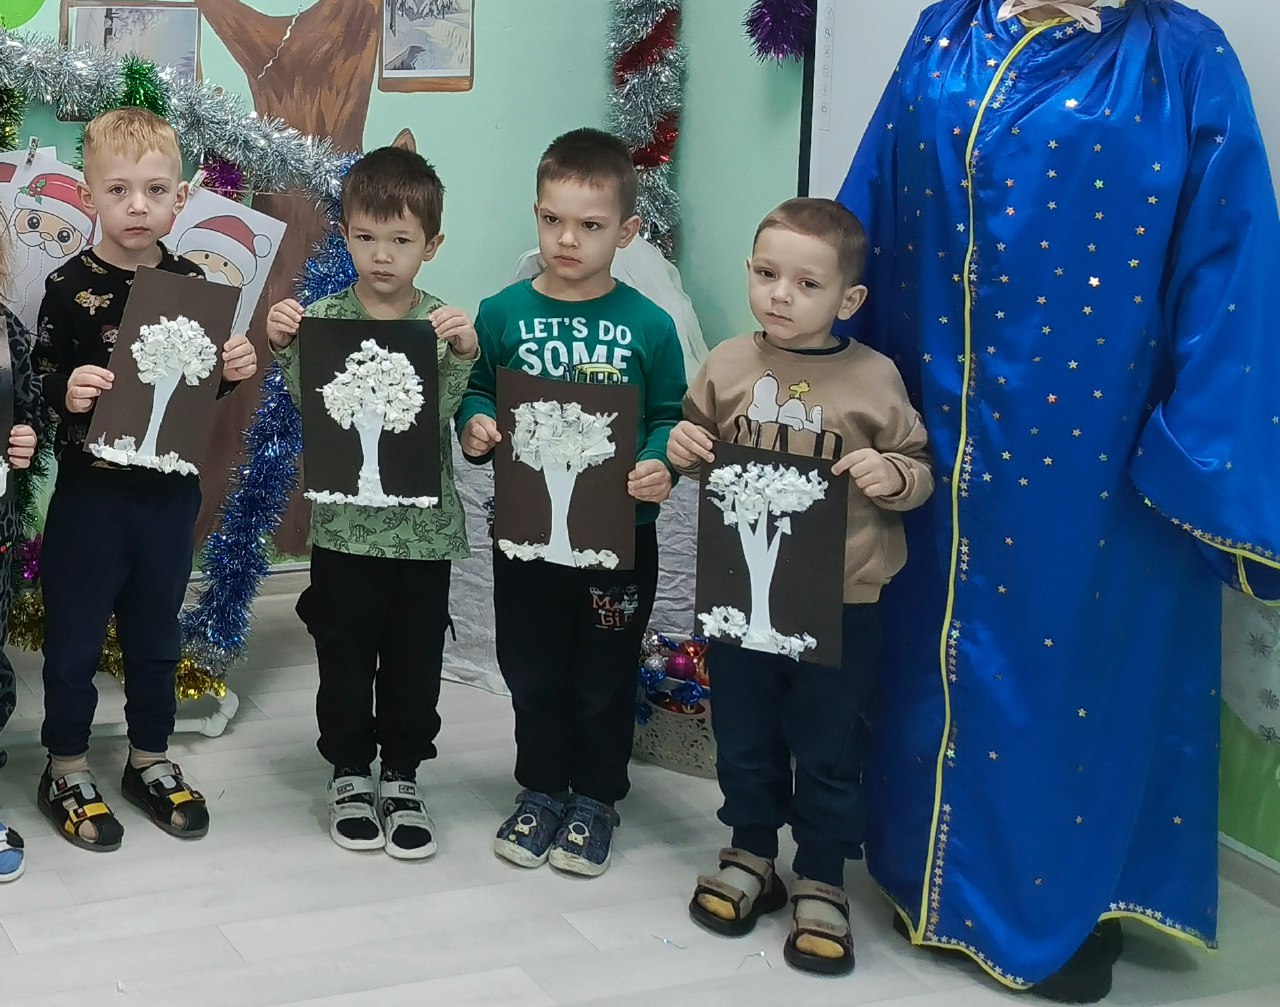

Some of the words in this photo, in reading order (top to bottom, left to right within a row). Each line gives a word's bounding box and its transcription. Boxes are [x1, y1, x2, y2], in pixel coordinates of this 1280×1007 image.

[518, 317, 589, 340] LET'S
[598, 320, 632, 345] DO
[517, 340, 632, 383] SOME
